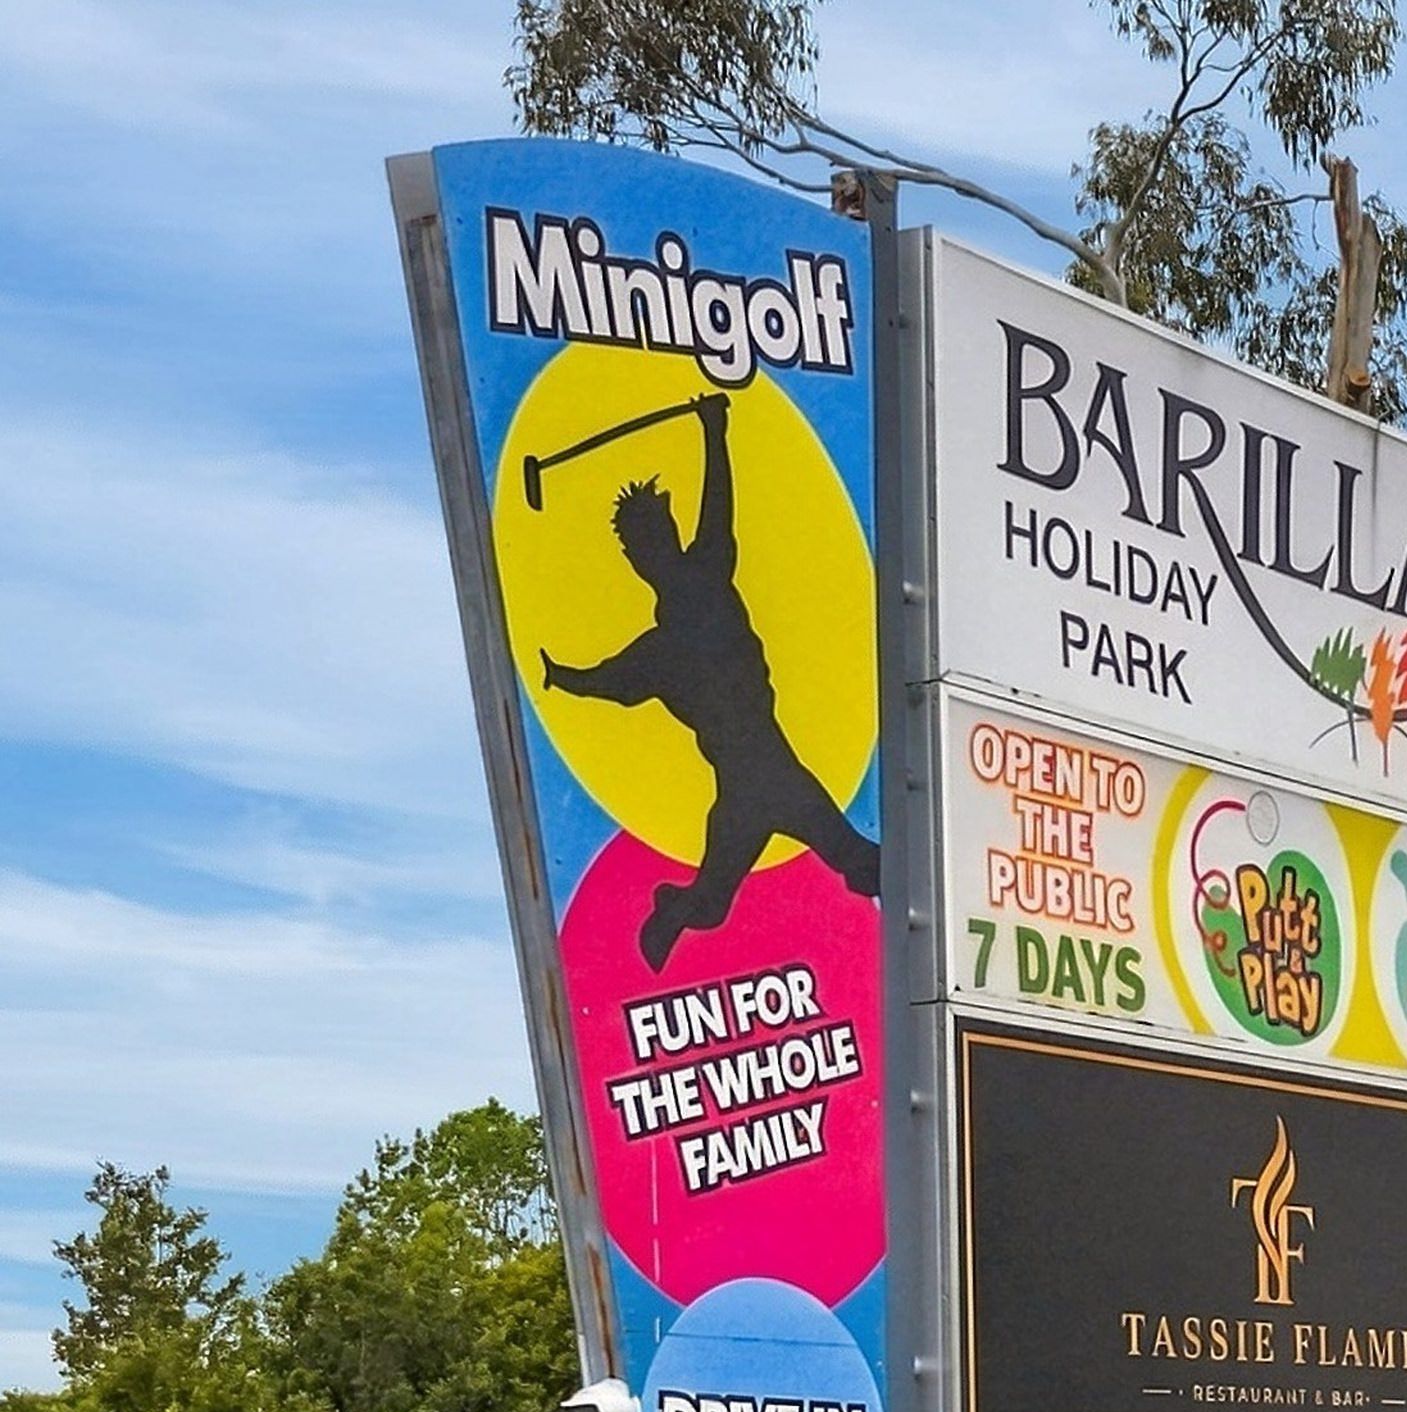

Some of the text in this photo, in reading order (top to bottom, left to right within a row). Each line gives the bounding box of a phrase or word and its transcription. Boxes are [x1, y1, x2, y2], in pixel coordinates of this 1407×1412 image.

[488, 209, 850, 387] Minigolf
[1004, 500, 1219, 626] HOLIDAY
[1059, 610, 1192, 704] PARK
[971, 723, 1145, 817] OPEN TO
[1014, 794, 1094, 867] THE
[987, 848, 1135, 933] PUBLIC
[1236, 864, 1322, 959] Putt
[968, 918, 1147, 1013] 7 DAYS
[1238, 950, 1322, 1037] Play
[628, 967, 822, 1060] FUN FOR
[609, 1023, 861, 1137] THE WHOLE
[677, 1100, 826, 1192] FAMILY
[1121, 1312, 1275, 1363] TASSIE
[1193, 1384, 1307, 1405] RESTAURANT
[1331, 1390, 1364, 1406] BAR
